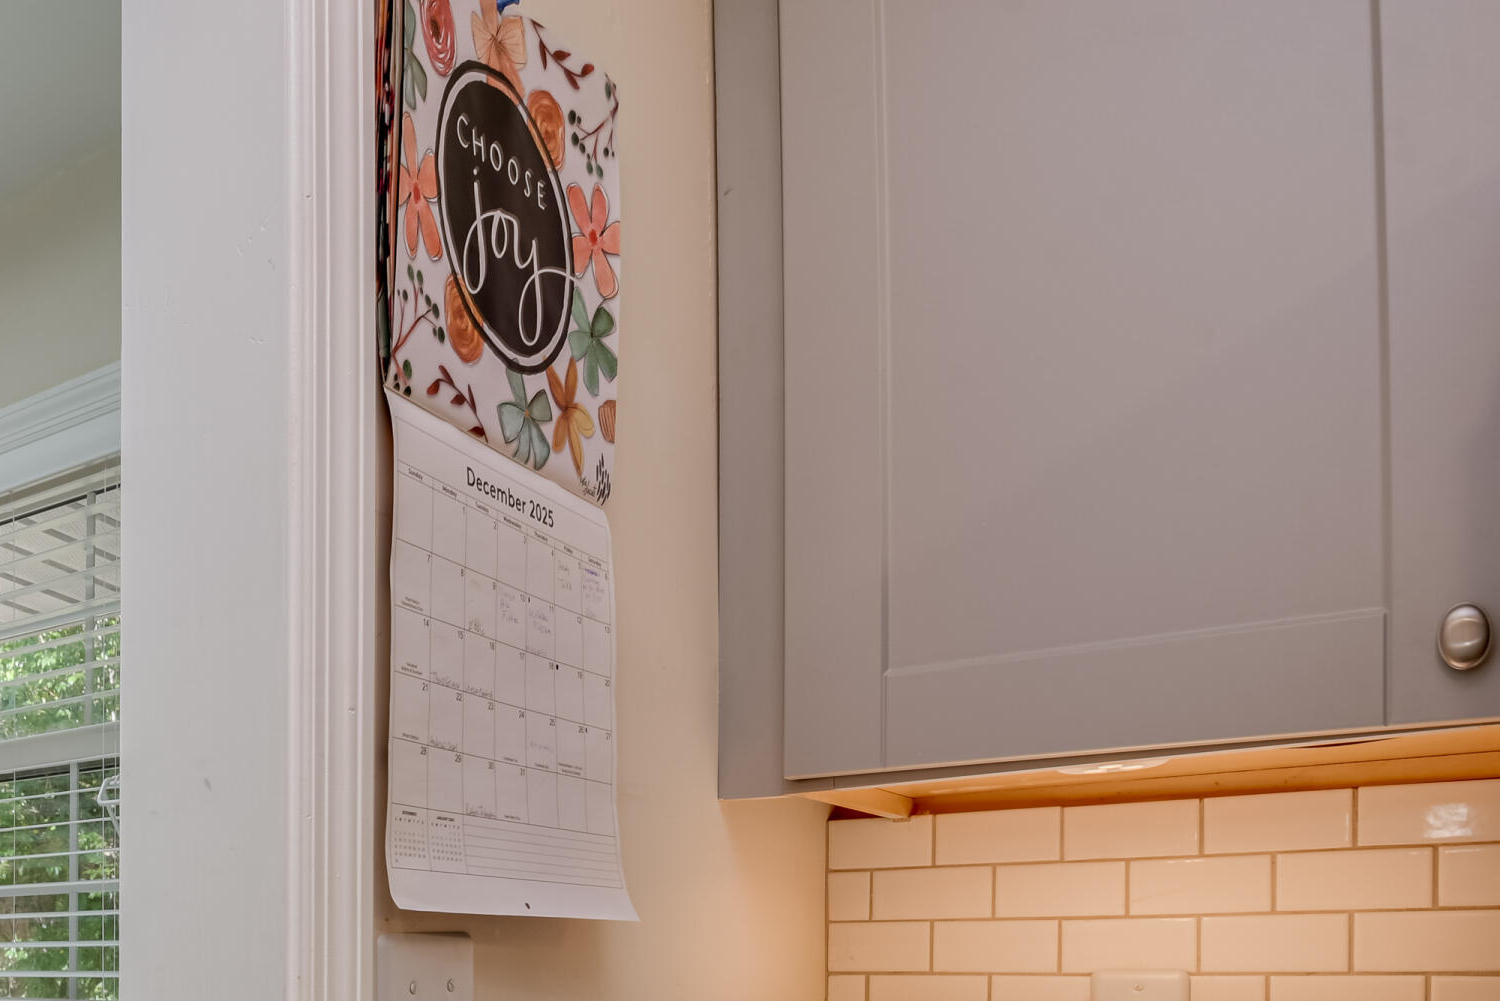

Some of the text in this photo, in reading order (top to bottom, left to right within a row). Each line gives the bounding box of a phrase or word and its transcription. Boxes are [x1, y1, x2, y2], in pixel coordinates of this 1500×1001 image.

[456, 115, 548, 211] CHOOSE
[463, 167, 576, 347] joy
[408, 467, 423, 481] Sunday
[466, 466, 554, 528] December 2025
